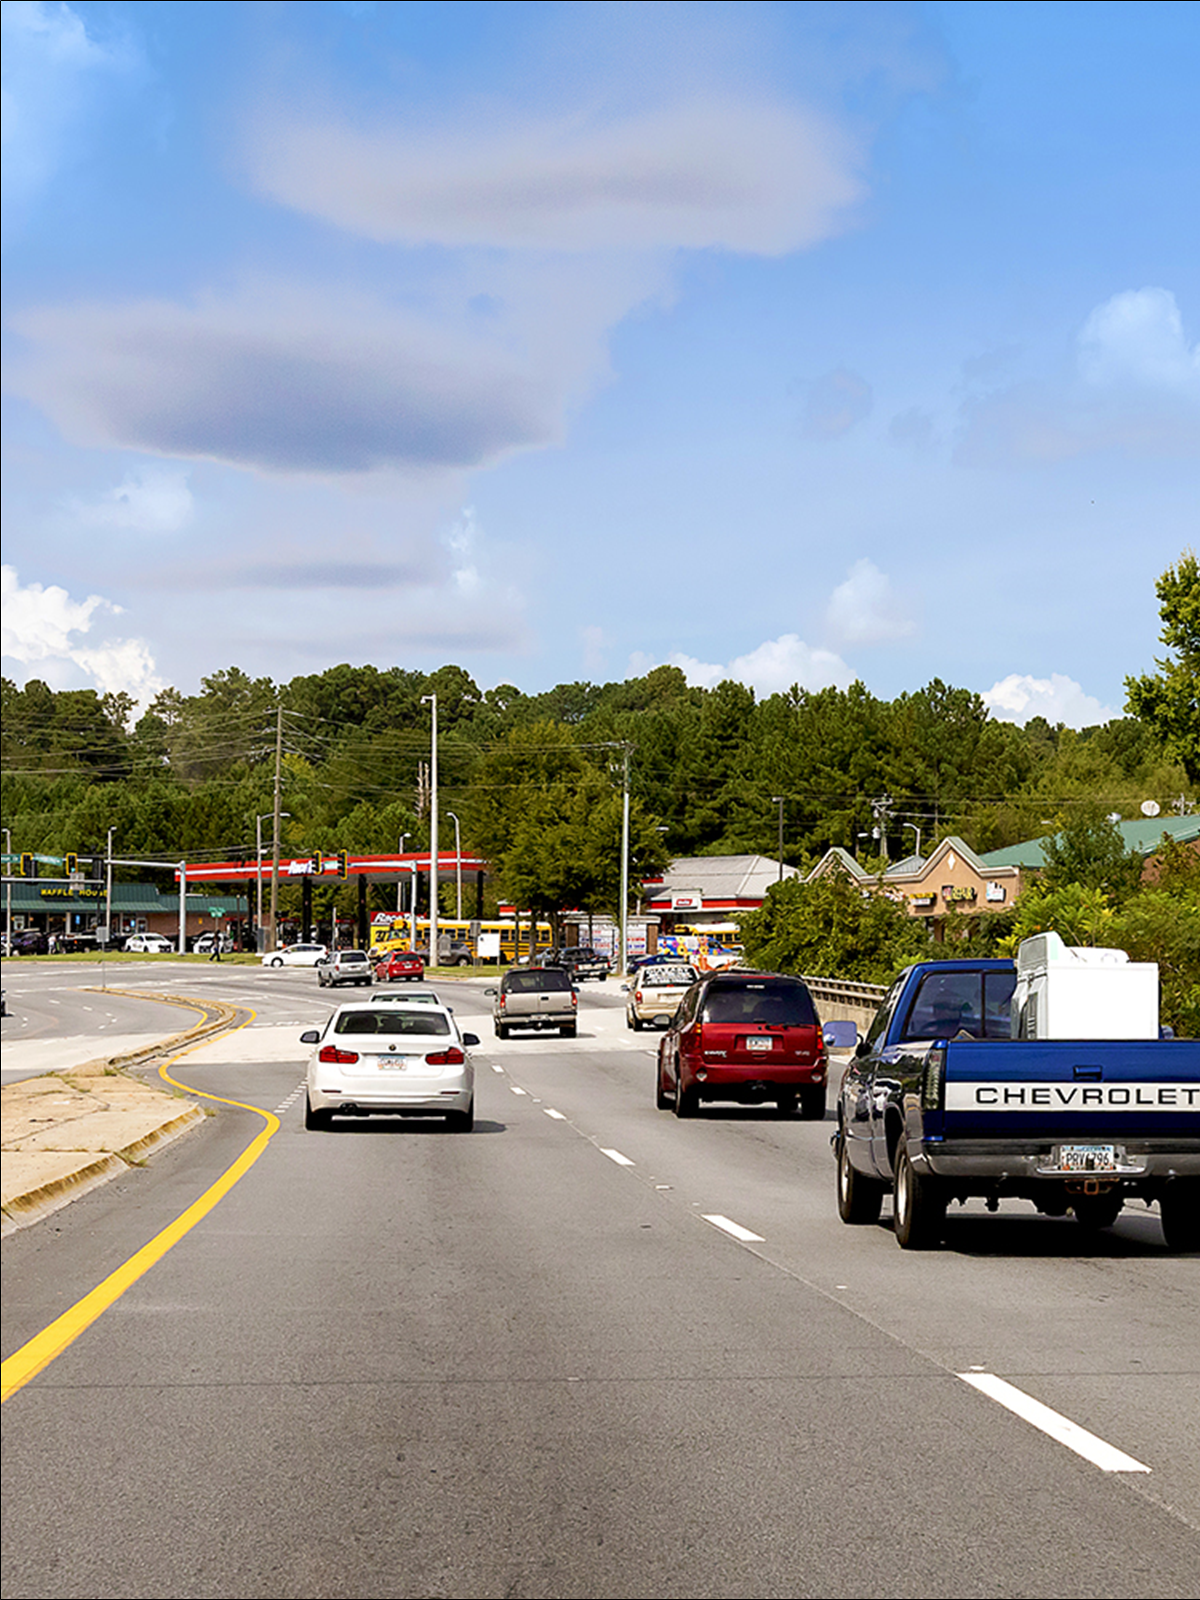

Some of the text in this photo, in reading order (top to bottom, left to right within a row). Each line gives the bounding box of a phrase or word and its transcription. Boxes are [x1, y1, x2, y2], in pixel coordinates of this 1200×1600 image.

[41, 888, 108, 898] WAFFLE HOUE
[975, 1087, 1200, 1105] CHEVROLET
